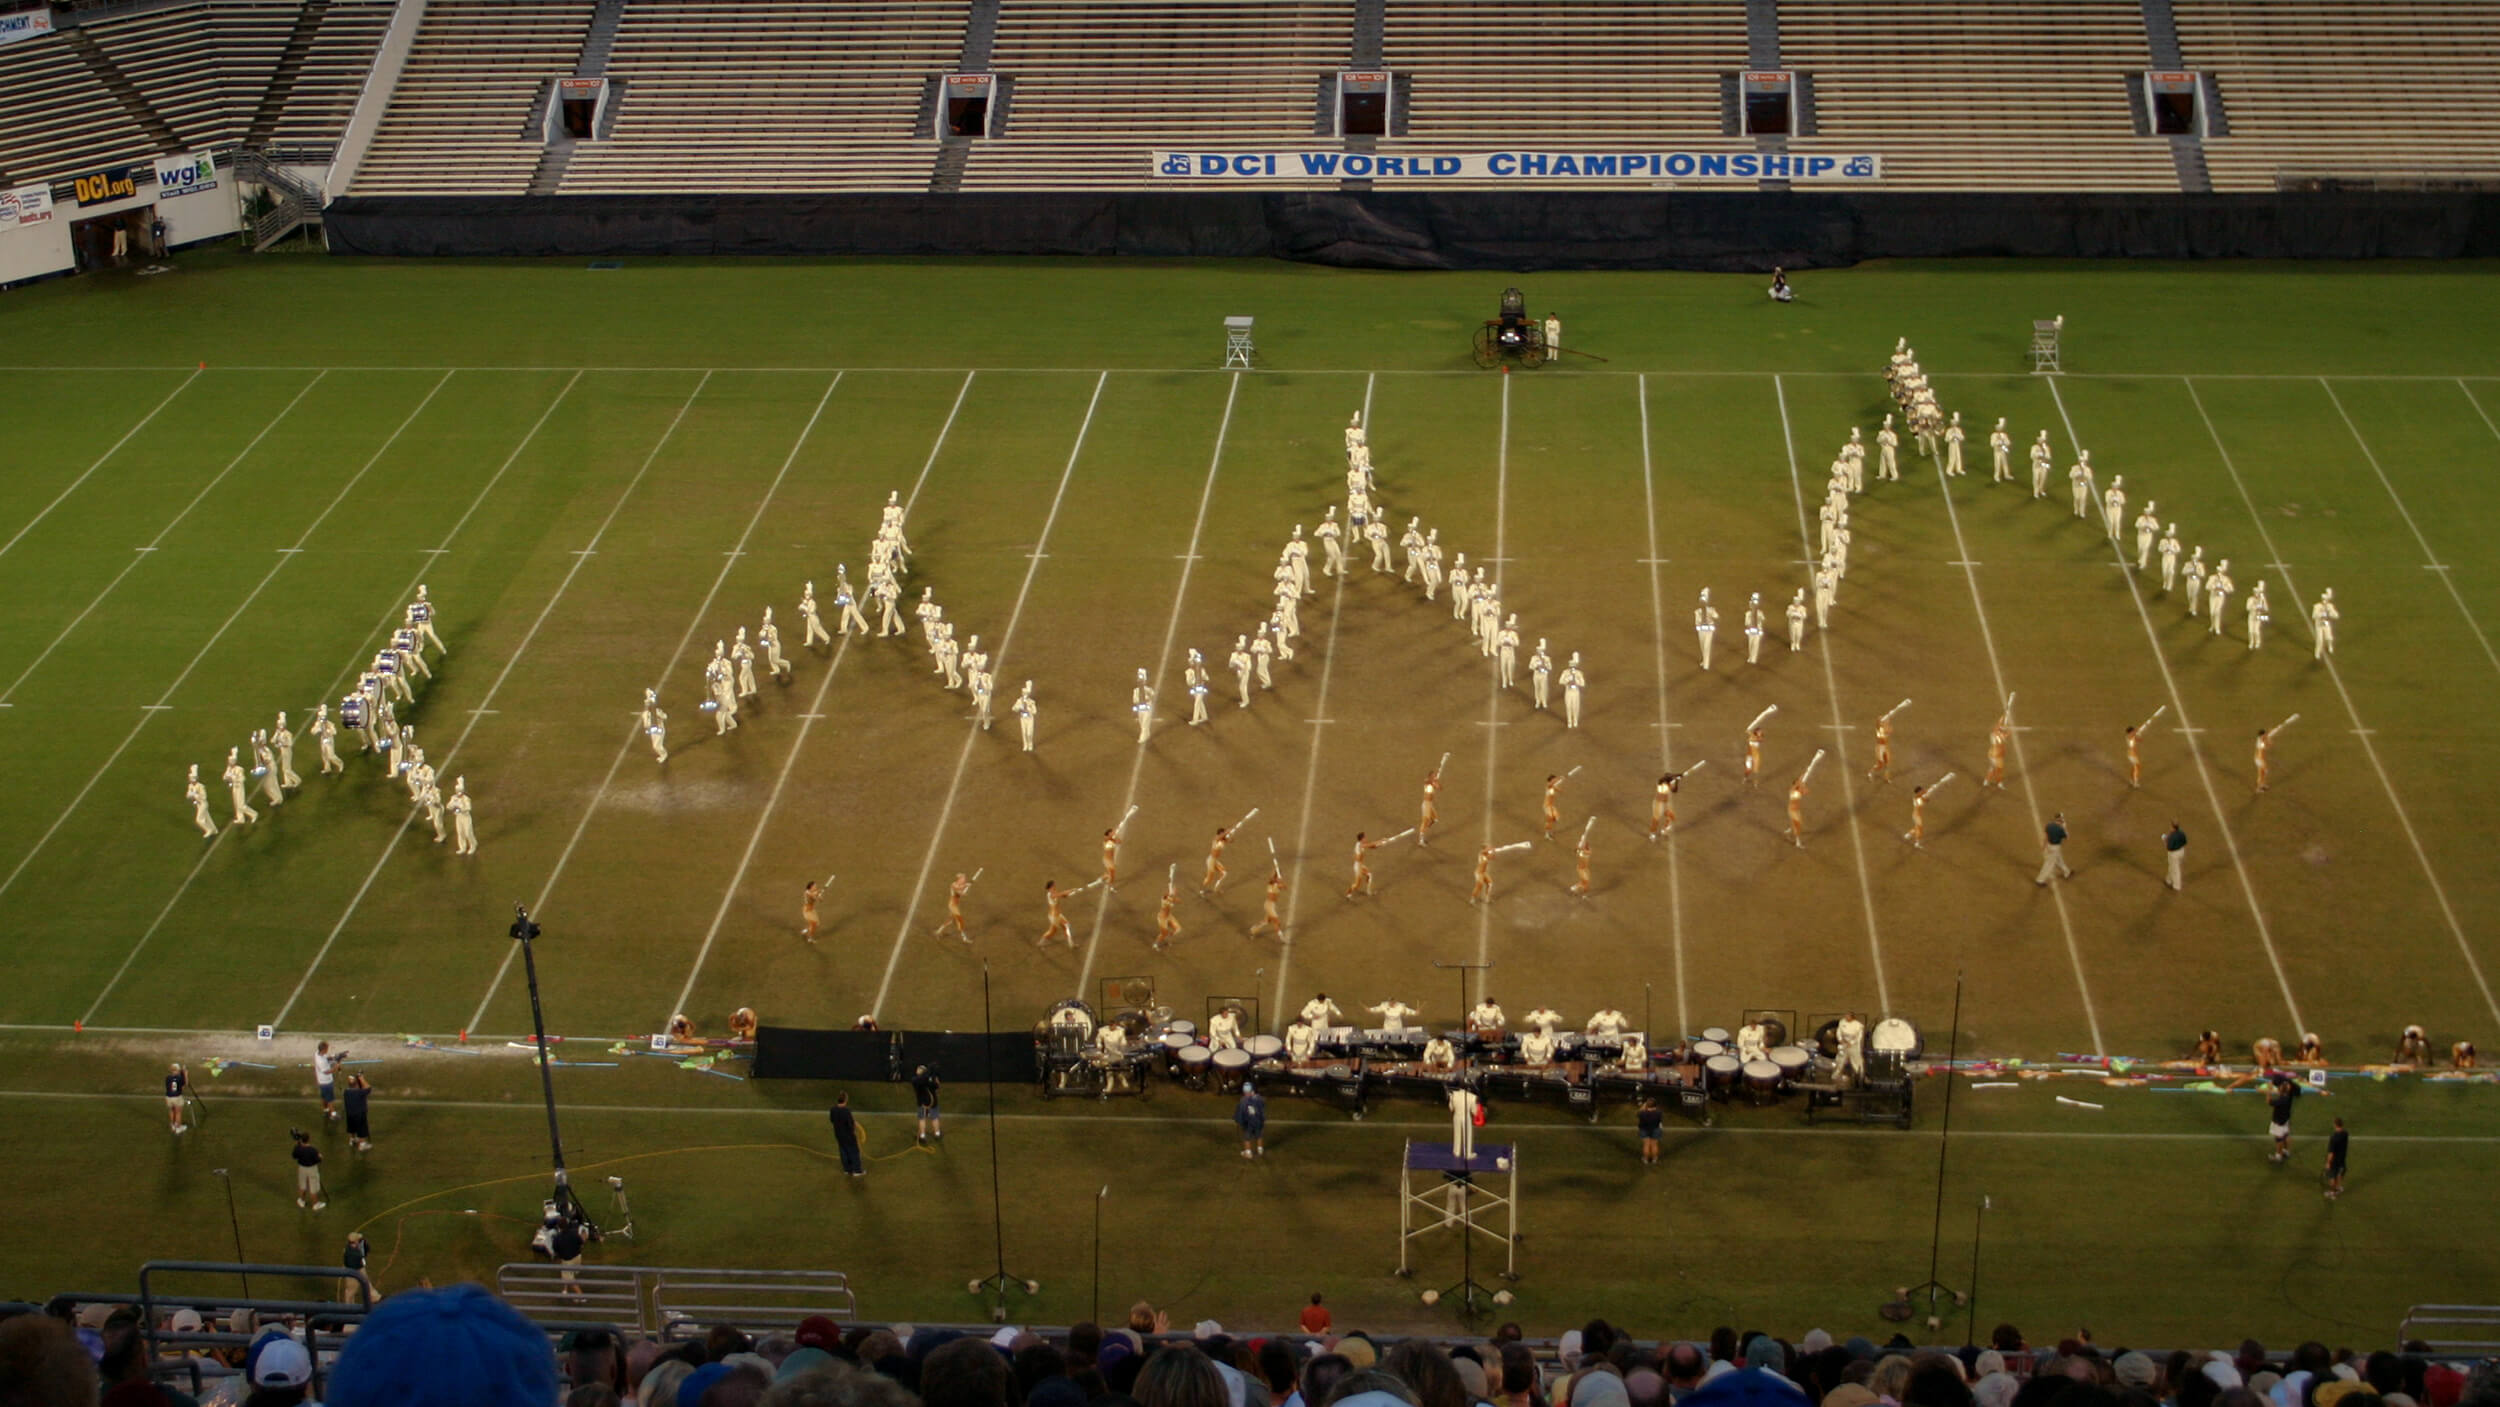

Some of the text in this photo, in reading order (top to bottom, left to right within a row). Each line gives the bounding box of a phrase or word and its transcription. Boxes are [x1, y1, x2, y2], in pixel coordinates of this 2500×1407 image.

[160, 160, 202, 186] wgi
[1200, 154, 1276, 176] DCI
[1300, 153, 1462, 176] WORLD
[1487, 153, 1835, 177] CHAMPIONSHIP
[75, 173, 134, 203] DCI.org
